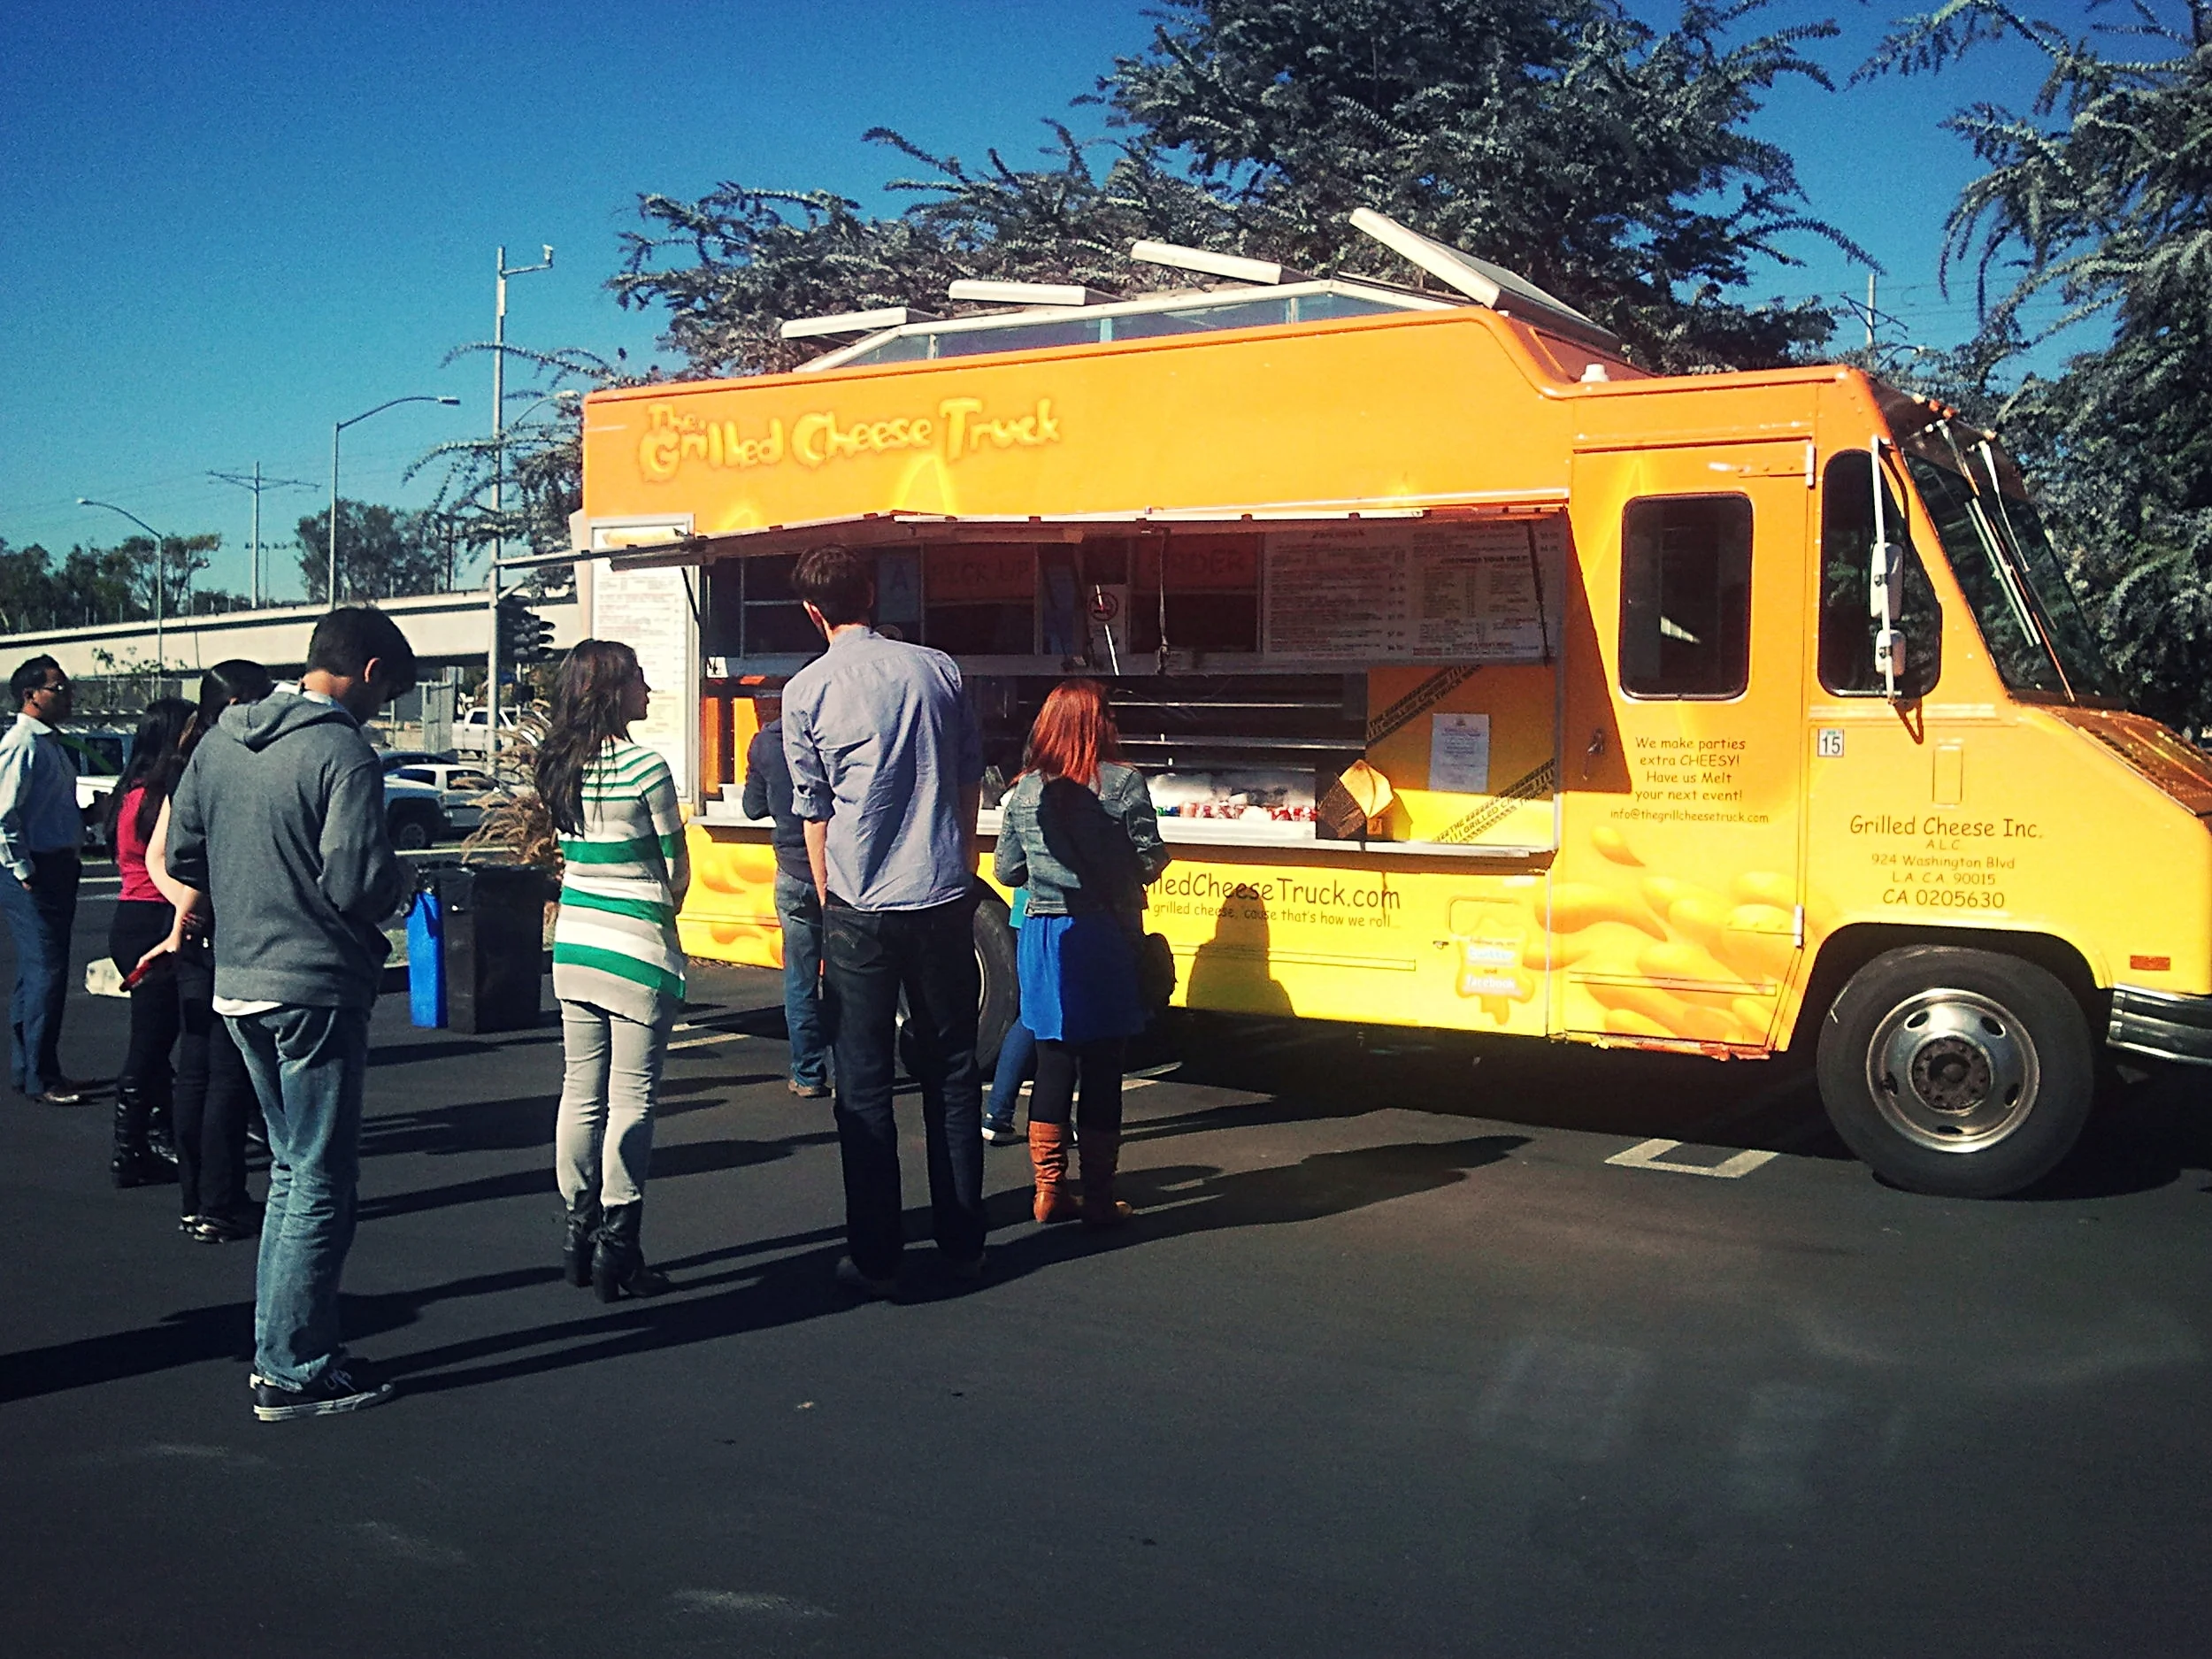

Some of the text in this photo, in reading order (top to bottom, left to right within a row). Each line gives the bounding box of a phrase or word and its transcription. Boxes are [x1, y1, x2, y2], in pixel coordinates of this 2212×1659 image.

[648, 403, 696, 431] The
[638, 396, 1061, 482] Grilled Cheese Truck
[1635, 737, 1746, 752] We make parties
[1822, 735, 1840, 754] 15
[1640, 755, 1740, 767] extra CHEESY!
[1647, 772, 1732, 784] Have us Melt
[1635, 790, 1743, 803] your next event!
[1850, 815, 2043, 838] Grilled Cheese Inc.
[1872, 853, 2016, 871] 924 Washington Blvd
[1954, 872, 1995, 885] 90015
[1883, 889, 2005, 909] CA 0205630
[1154, 901, 1190, 917] grilled
[1281, 909, 1317, 923] that's
[1320, 911, 1344, 926] how
[1348, 917, 1365, 926] we
